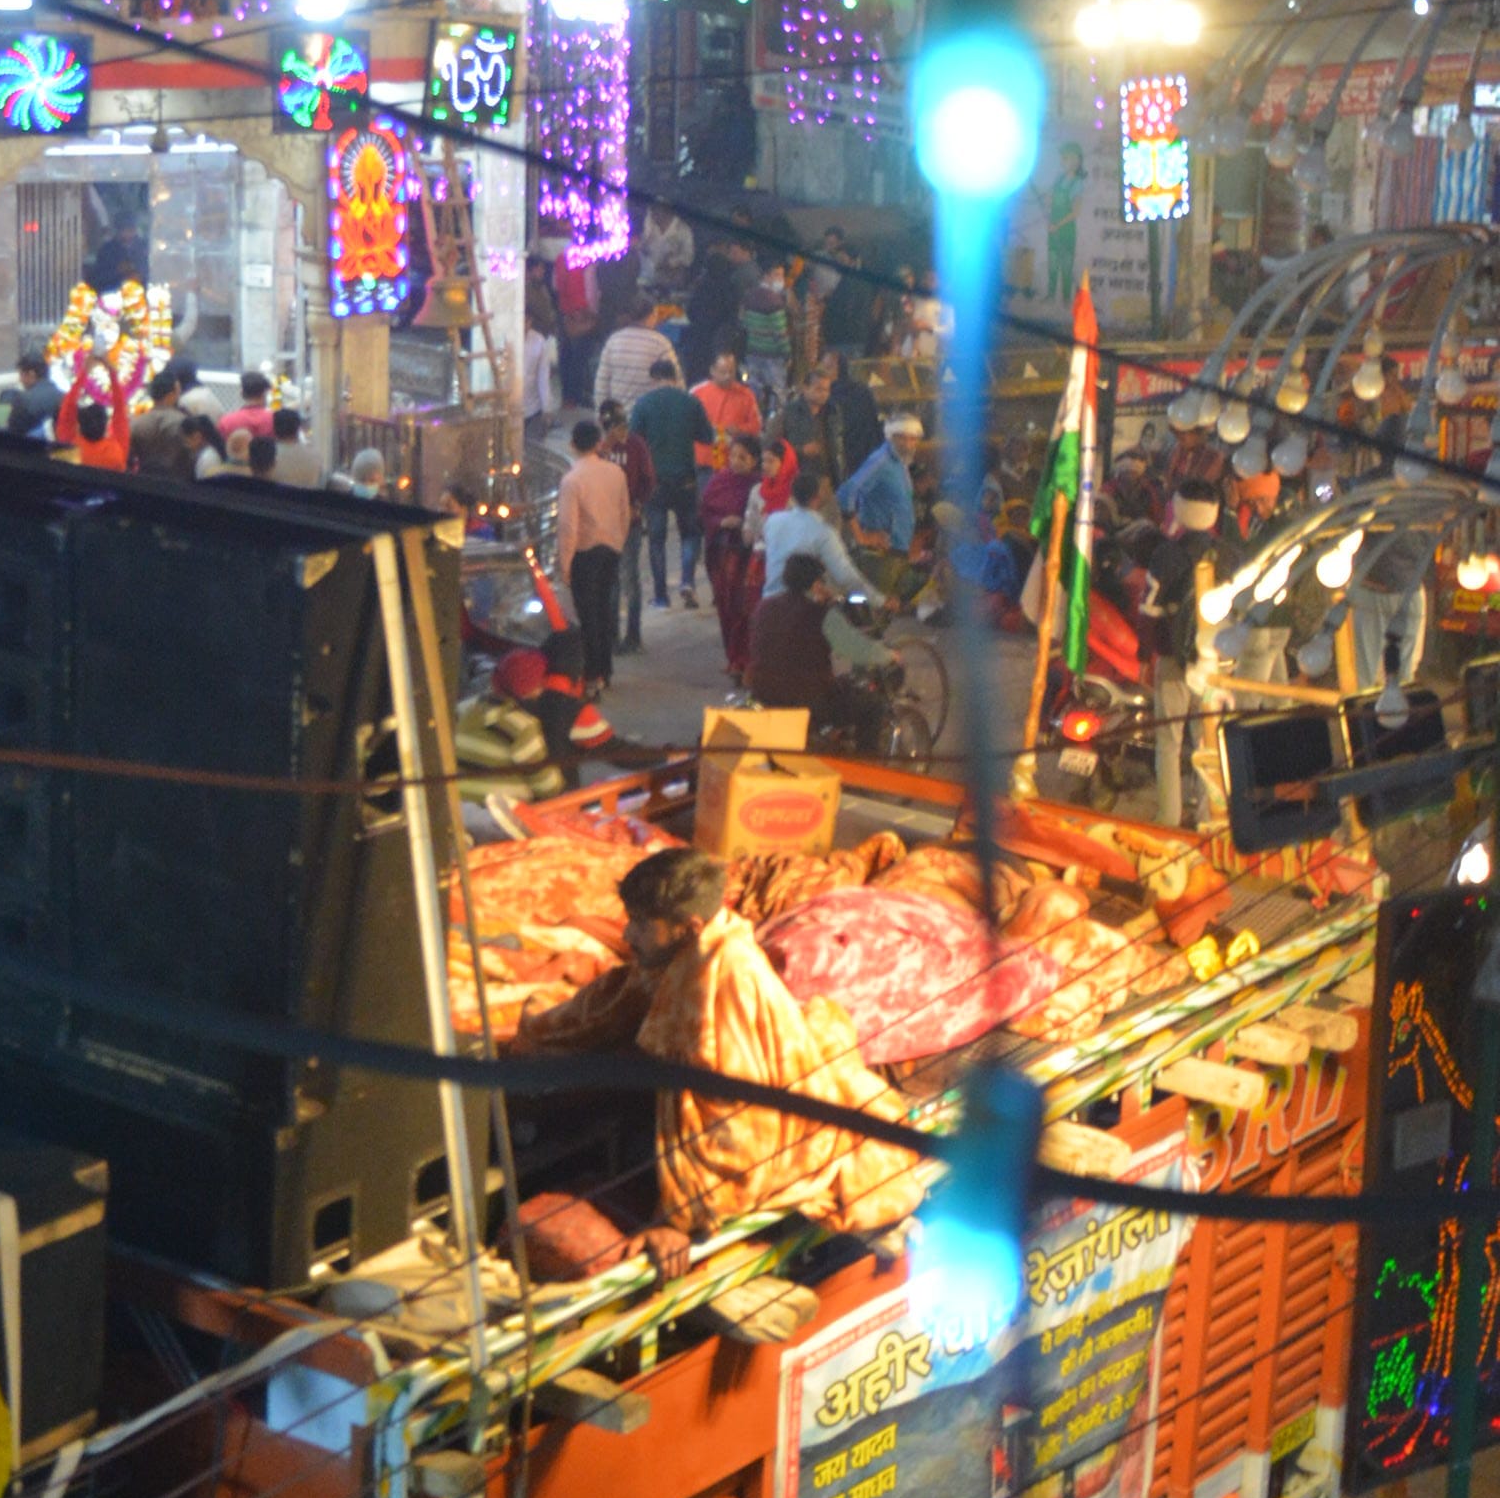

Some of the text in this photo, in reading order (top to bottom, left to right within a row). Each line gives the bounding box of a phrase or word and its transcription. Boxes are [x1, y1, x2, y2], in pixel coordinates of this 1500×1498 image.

[816, 1331, 932, 1428] अहीर
[813, 1422, 899, 1489] जय यादव
